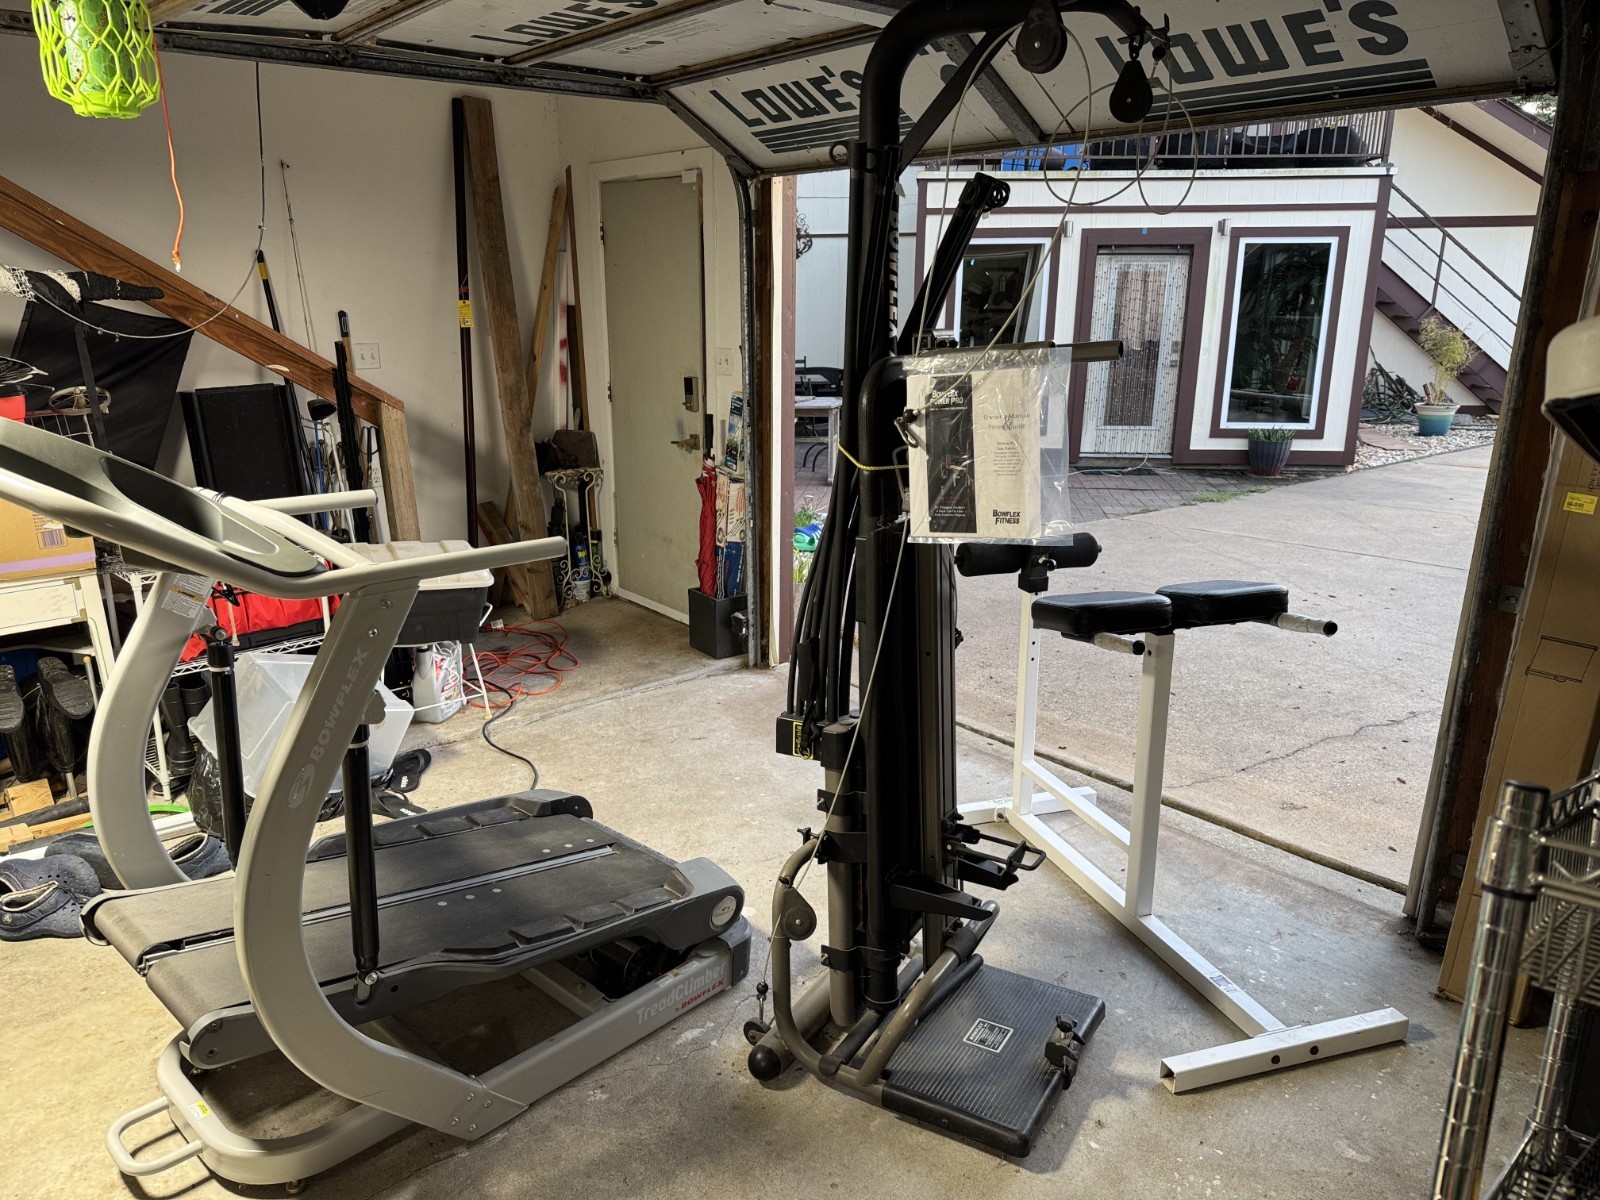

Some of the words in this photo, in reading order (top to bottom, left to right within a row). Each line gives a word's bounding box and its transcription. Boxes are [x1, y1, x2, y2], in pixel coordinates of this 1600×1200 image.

[1095, 0, 1409, 88] LOWE'S
[709, 65, 861, 128] LOWE'S
[888, 209, 899, 338] BOWFLEX
[950, 396, 964, 405] PRO
[992, 509, 1021, 518] BOWFLEX
[995, 517, 1020, 525] FITNESS
[310, 647, 368, 762] BOWFLEX
[636, 961, 727, 1025] TreadClimber
[680, 978, 726, 1009] BOWFLEX
